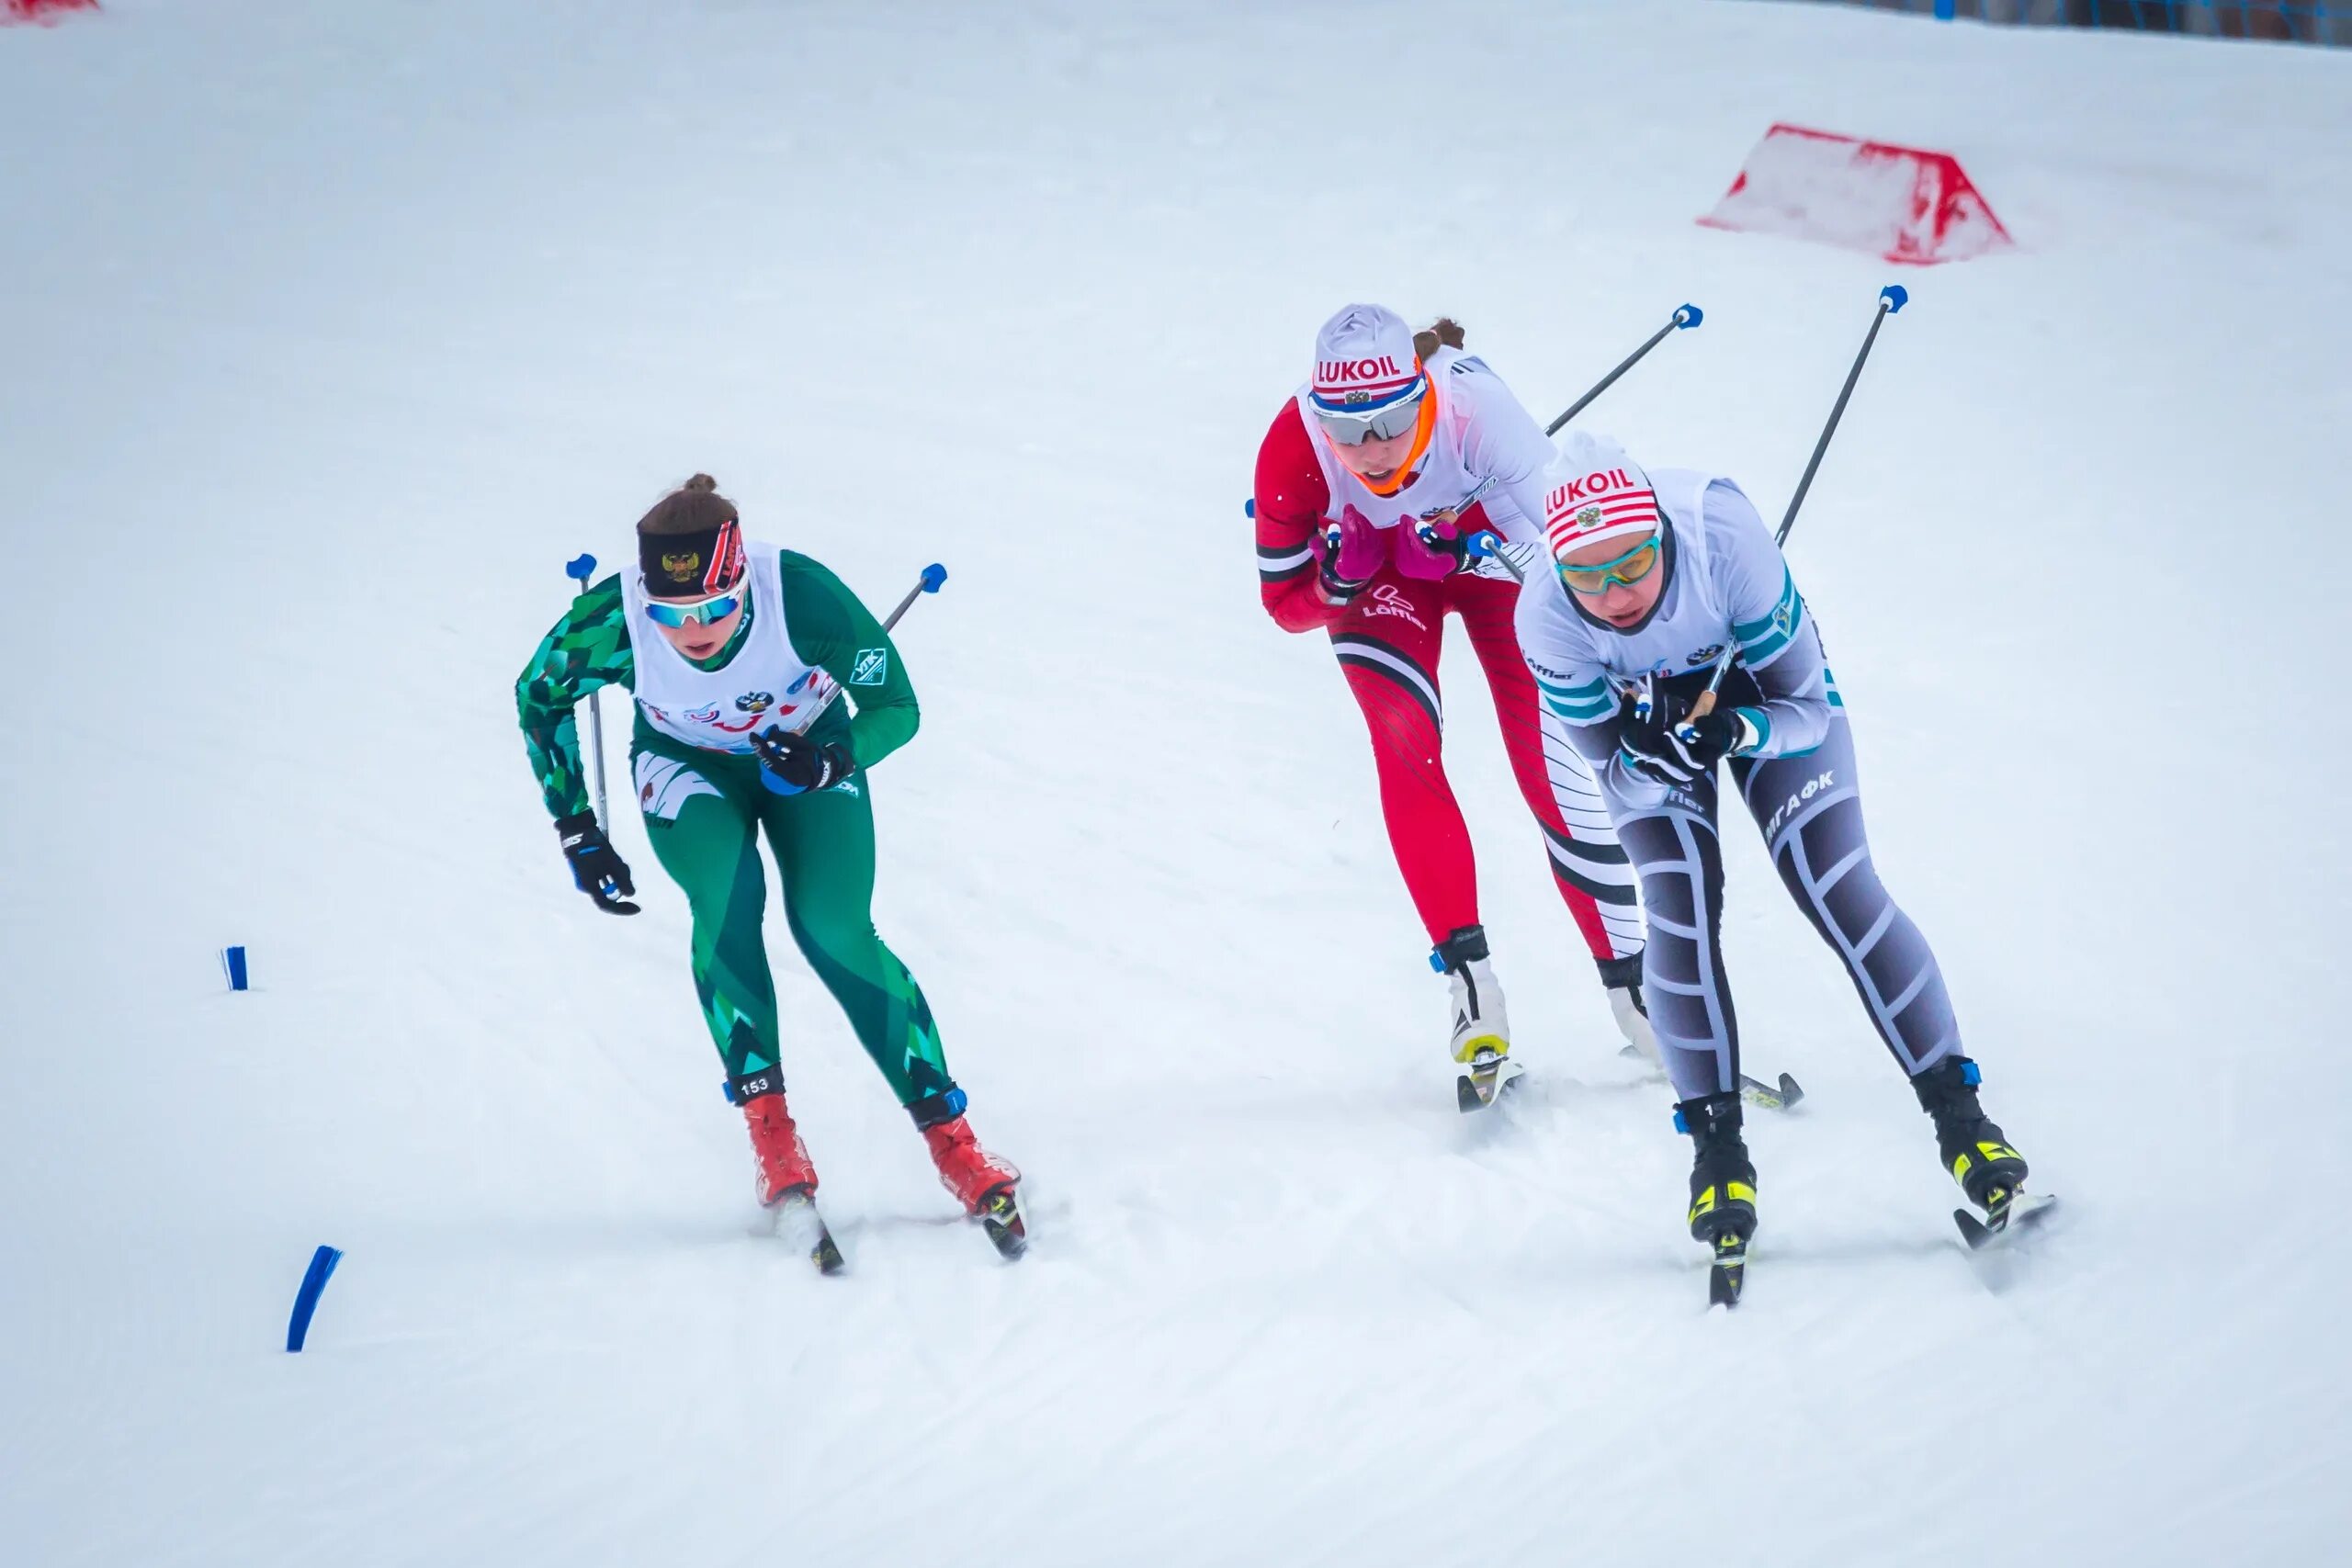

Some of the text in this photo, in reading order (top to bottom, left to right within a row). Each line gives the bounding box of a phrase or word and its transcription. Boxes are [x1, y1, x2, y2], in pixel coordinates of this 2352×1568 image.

[1318, 355, 1400, 382] LUKOIL
[1545, 468, 1634, 515] LUKOIL
[741, 1077, 769, 1096] 153
